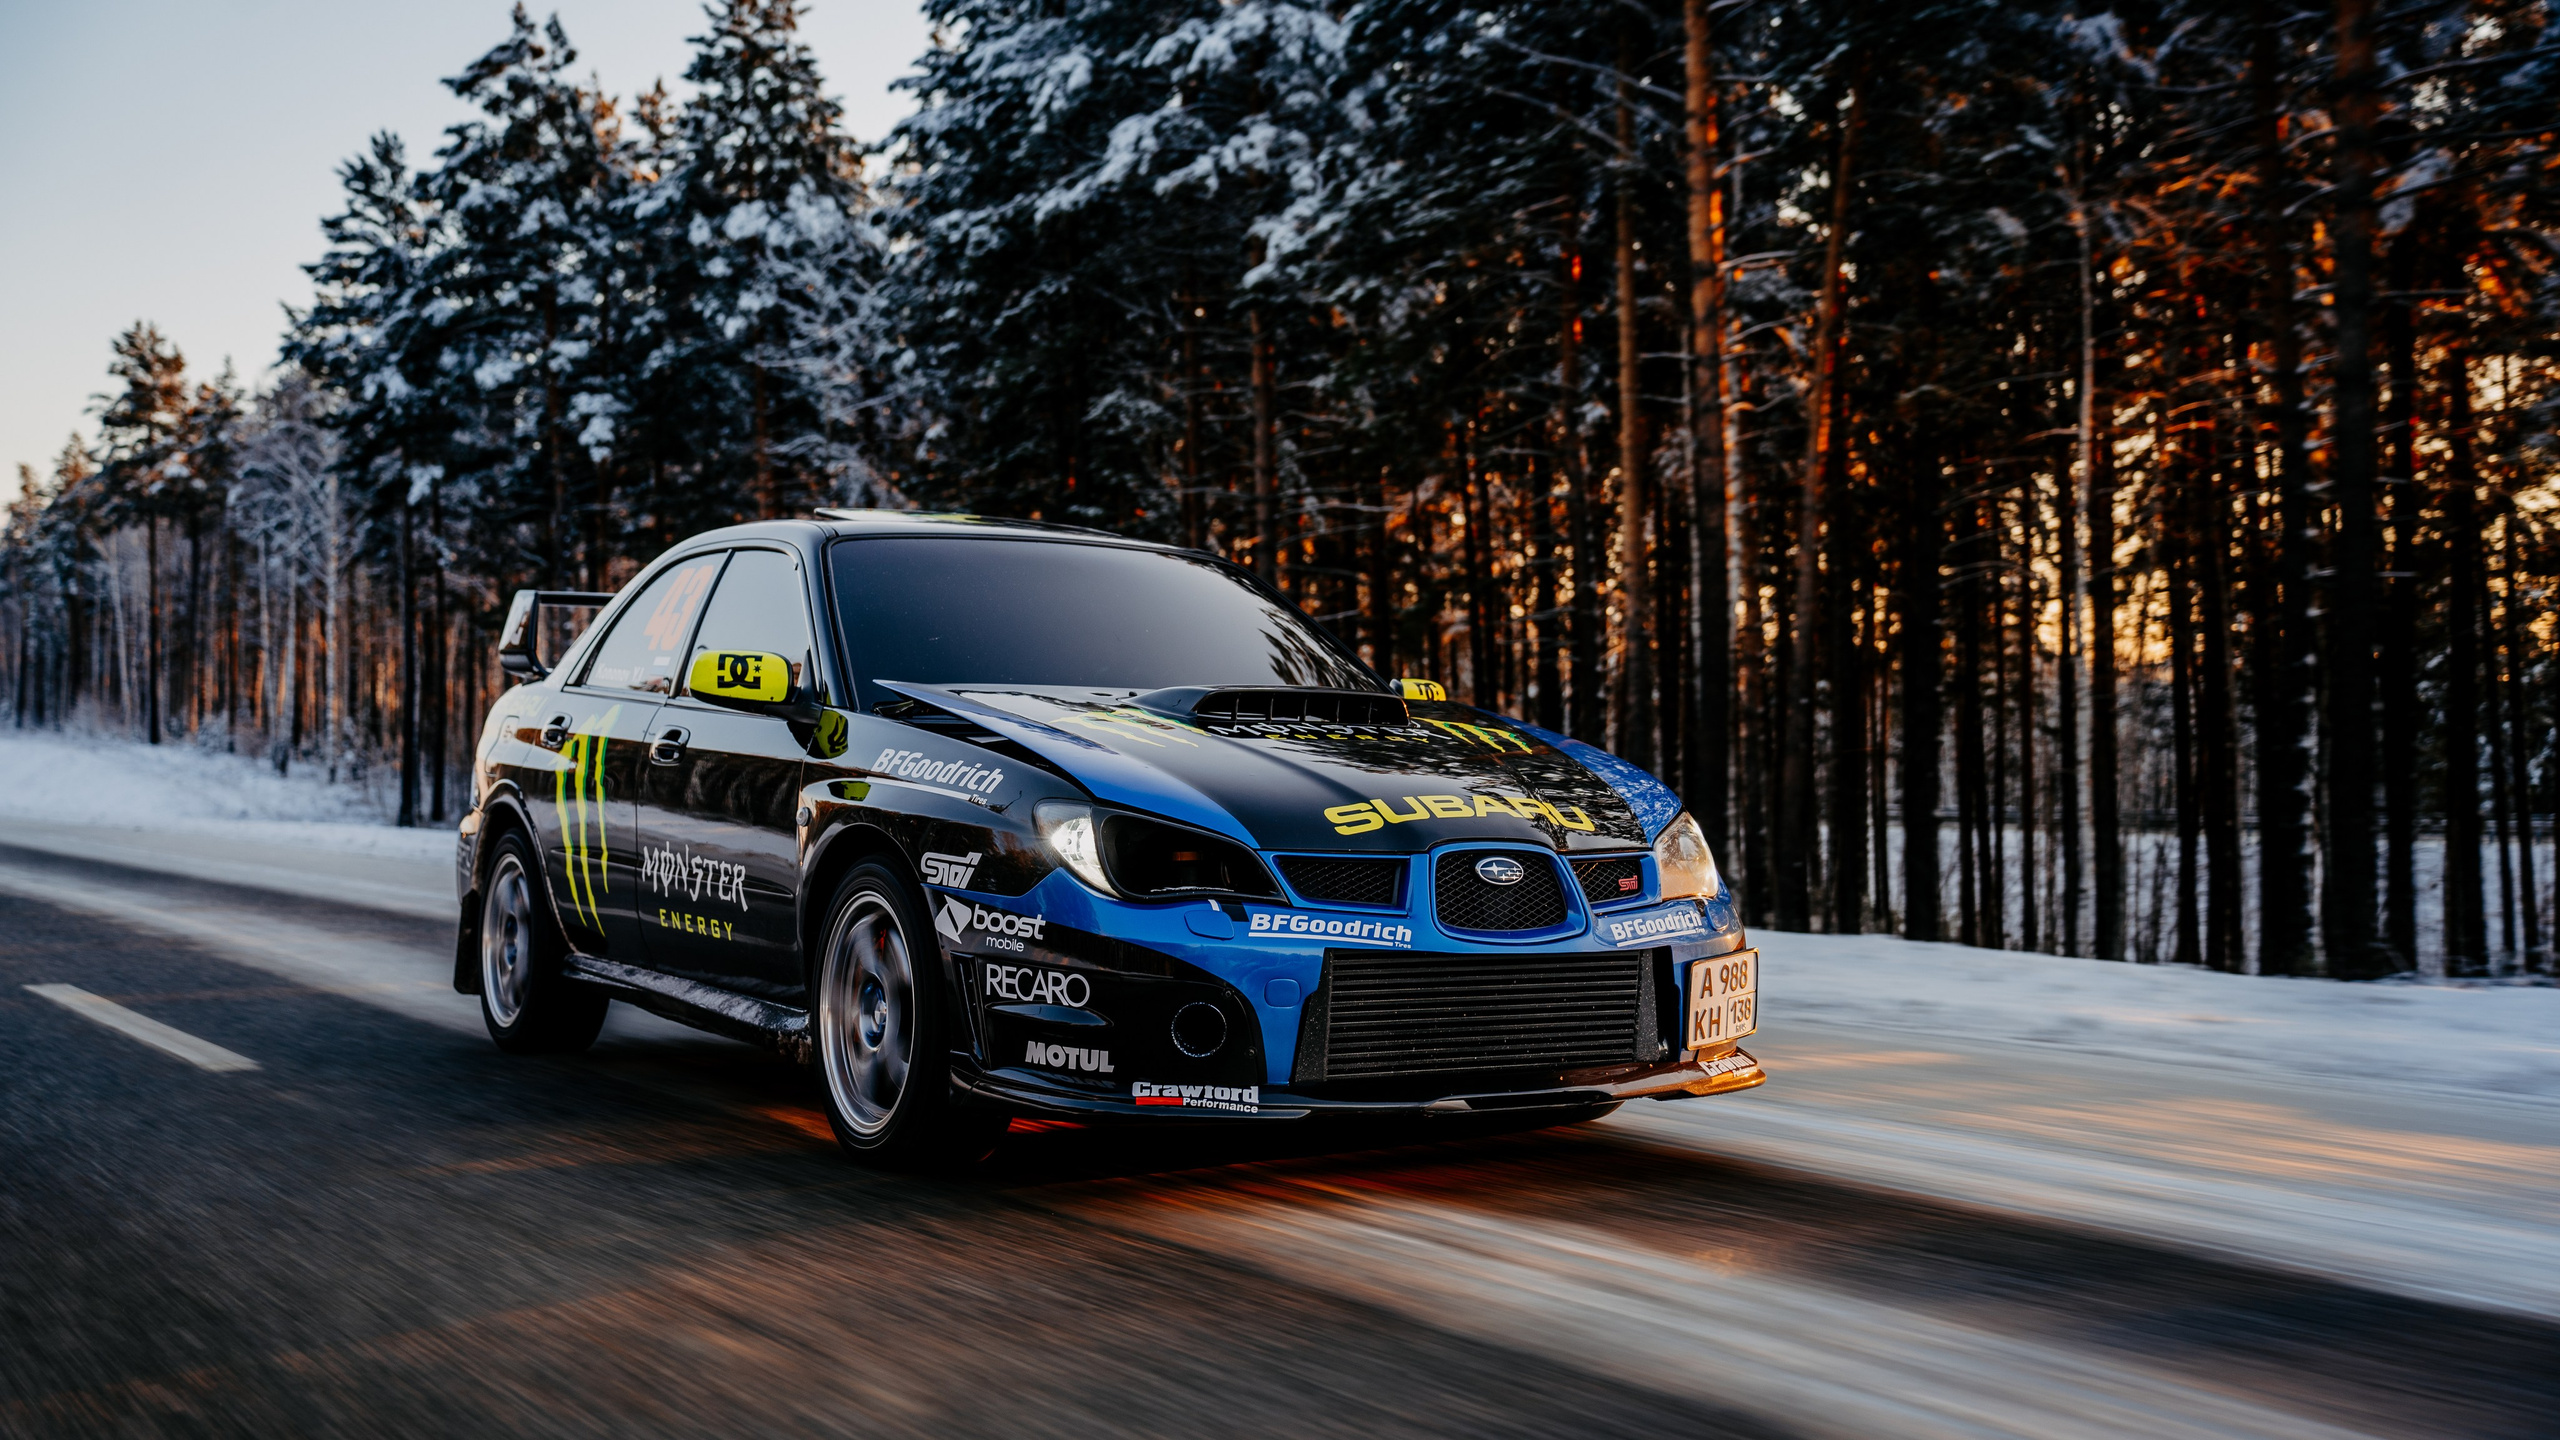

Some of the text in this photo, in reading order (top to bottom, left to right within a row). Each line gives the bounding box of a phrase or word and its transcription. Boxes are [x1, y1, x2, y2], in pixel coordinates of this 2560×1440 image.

[644, 564, 714, 651] 43
[870, 748, 1004, 794] BFGoodrich
[969, 793, 988, 805] Tires
[1323, 795, 1596, 835] SUBARU
[642, 840, 748, 912] MONSTER
[659, 908, 733, 941] ENERGY
[972, 903, 1046, 940] boost
[1250, 913, 1412, 942] BFGoodrich
[1610, 911, 1702, 941] BFGoodrich
[985, 936, 1025, 952] mobile
[1394, 941, 1411, 949] Tires
[986, 963, 1090, 1007] RECARO
[1700, 959, 1748, 999] A 988
[1694, 1005, 1721, 1041] KH
[1730, 997, 1751, 1024] 138
[1025, 1040, 1115, 1073] MOTUL
[1132, 1081, 1259, 1104] Crawford
[1182, 1097, 1258, 1114] Performance
